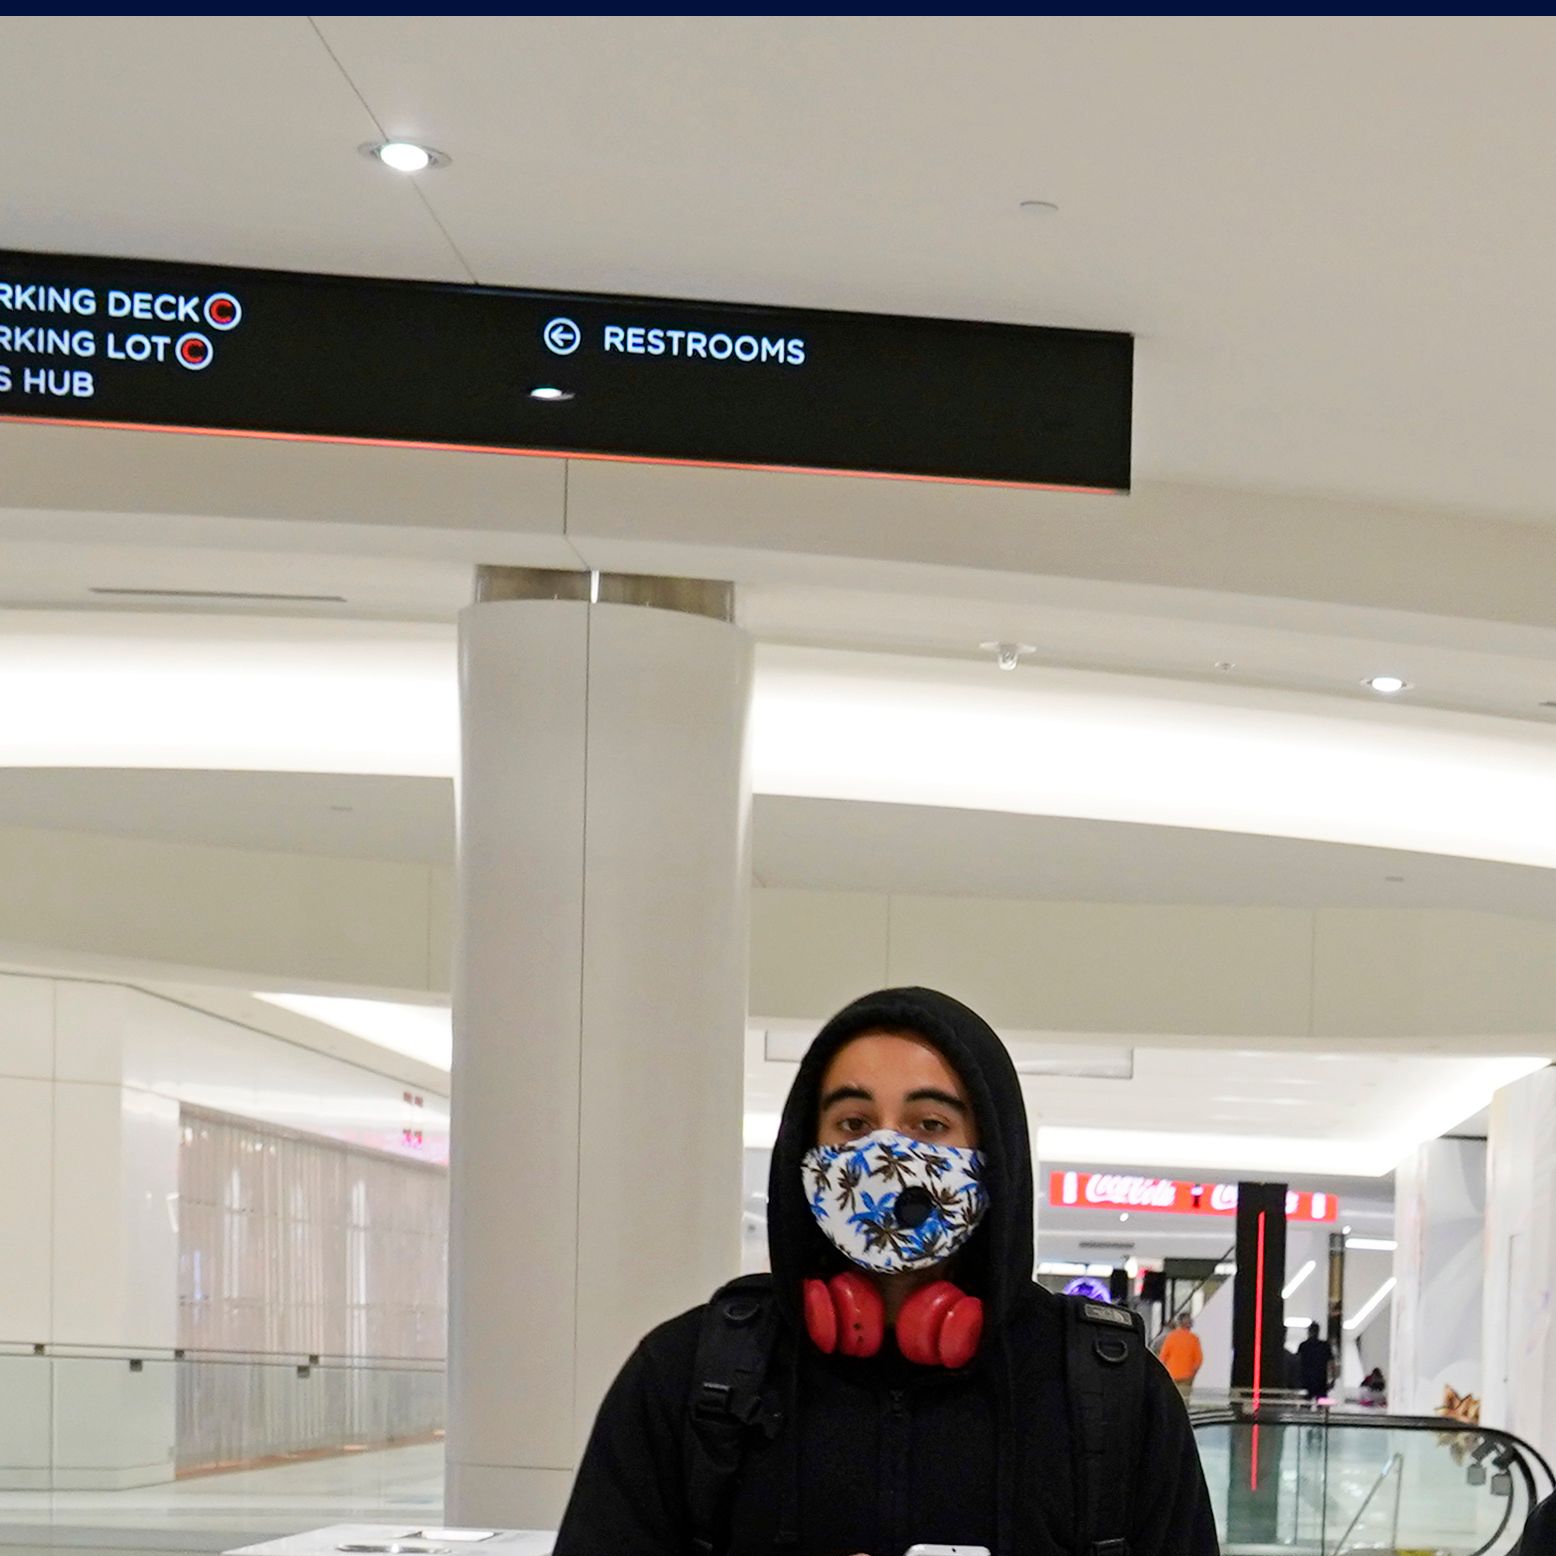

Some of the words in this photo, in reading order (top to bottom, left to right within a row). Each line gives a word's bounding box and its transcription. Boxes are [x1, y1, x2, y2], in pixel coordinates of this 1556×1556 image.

[108, 290, 200, 323] DECK
[107, 332, 171, 362] LOT
[603, 325, 805, 365] RESTROOMS
[24, 367, 95, 397] HUB
